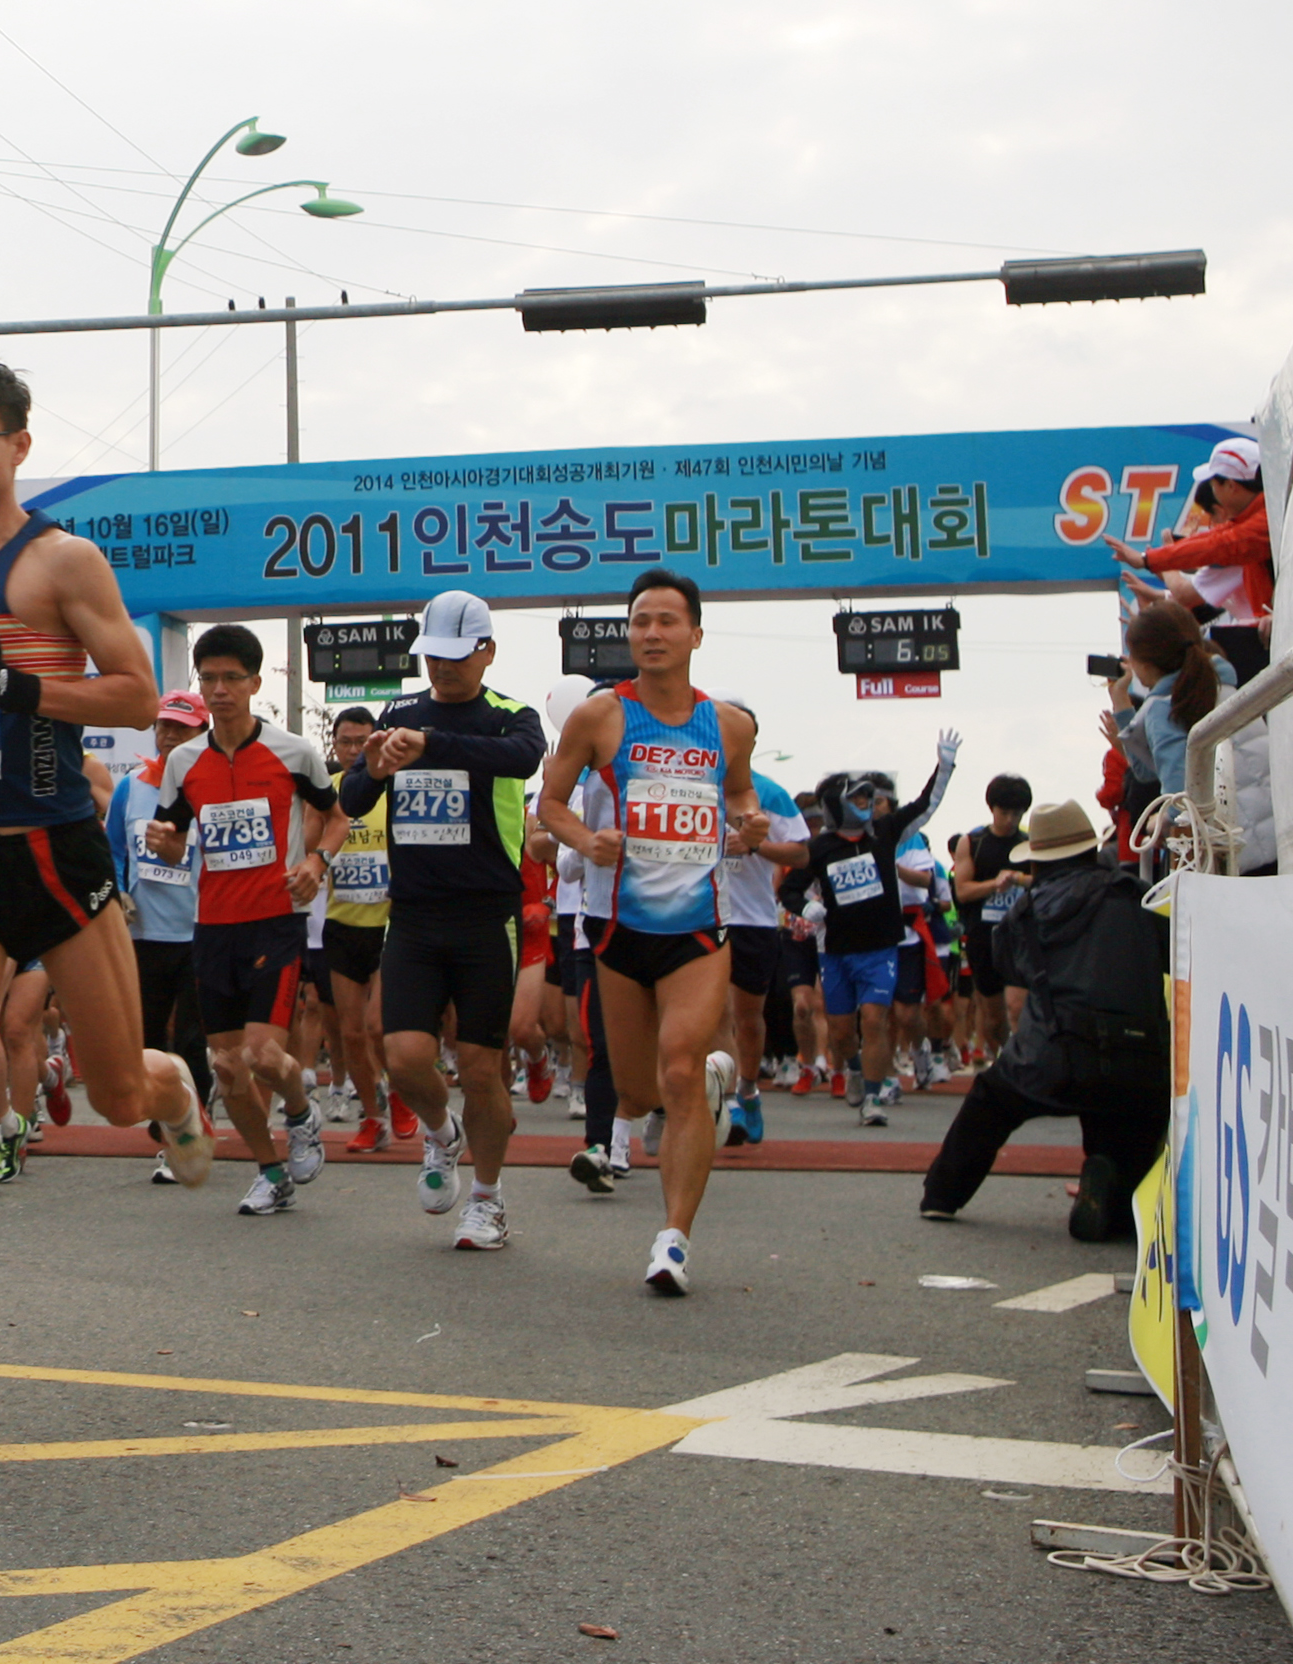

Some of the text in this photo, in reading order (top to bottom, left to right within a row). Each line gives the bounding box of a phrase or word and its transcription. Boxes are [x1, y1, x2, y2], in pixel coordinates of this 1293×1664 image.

[353, 474, 395, 493] 2014
[675, 456, 731, 478] 제47회
[737, 452, 844, 476] 인천시민의날
[852, 450, 887, 471] 기념
[86, 513, 133, 540] 10월
[142, 508, 230, 538] 16일(일)
[870, 614, 946, 633] SAM IK
[337, 625, 406, 644] SAM IK
[327, 684, 366, 699] 10km
[860, 677, 940, 696] Full Course
[405, 778, 453, 789] 포스코건설
[395, 790, 466, 818] 2479
[631, 802, 714, 836] 1180
[203, 817, 270, 848] 2738
[229, 850, 253, 863] D49
[153, 867, 174, 879] D73
[334, 865, 384, 886] 2251
[832, 865, 877, 891] 2450
